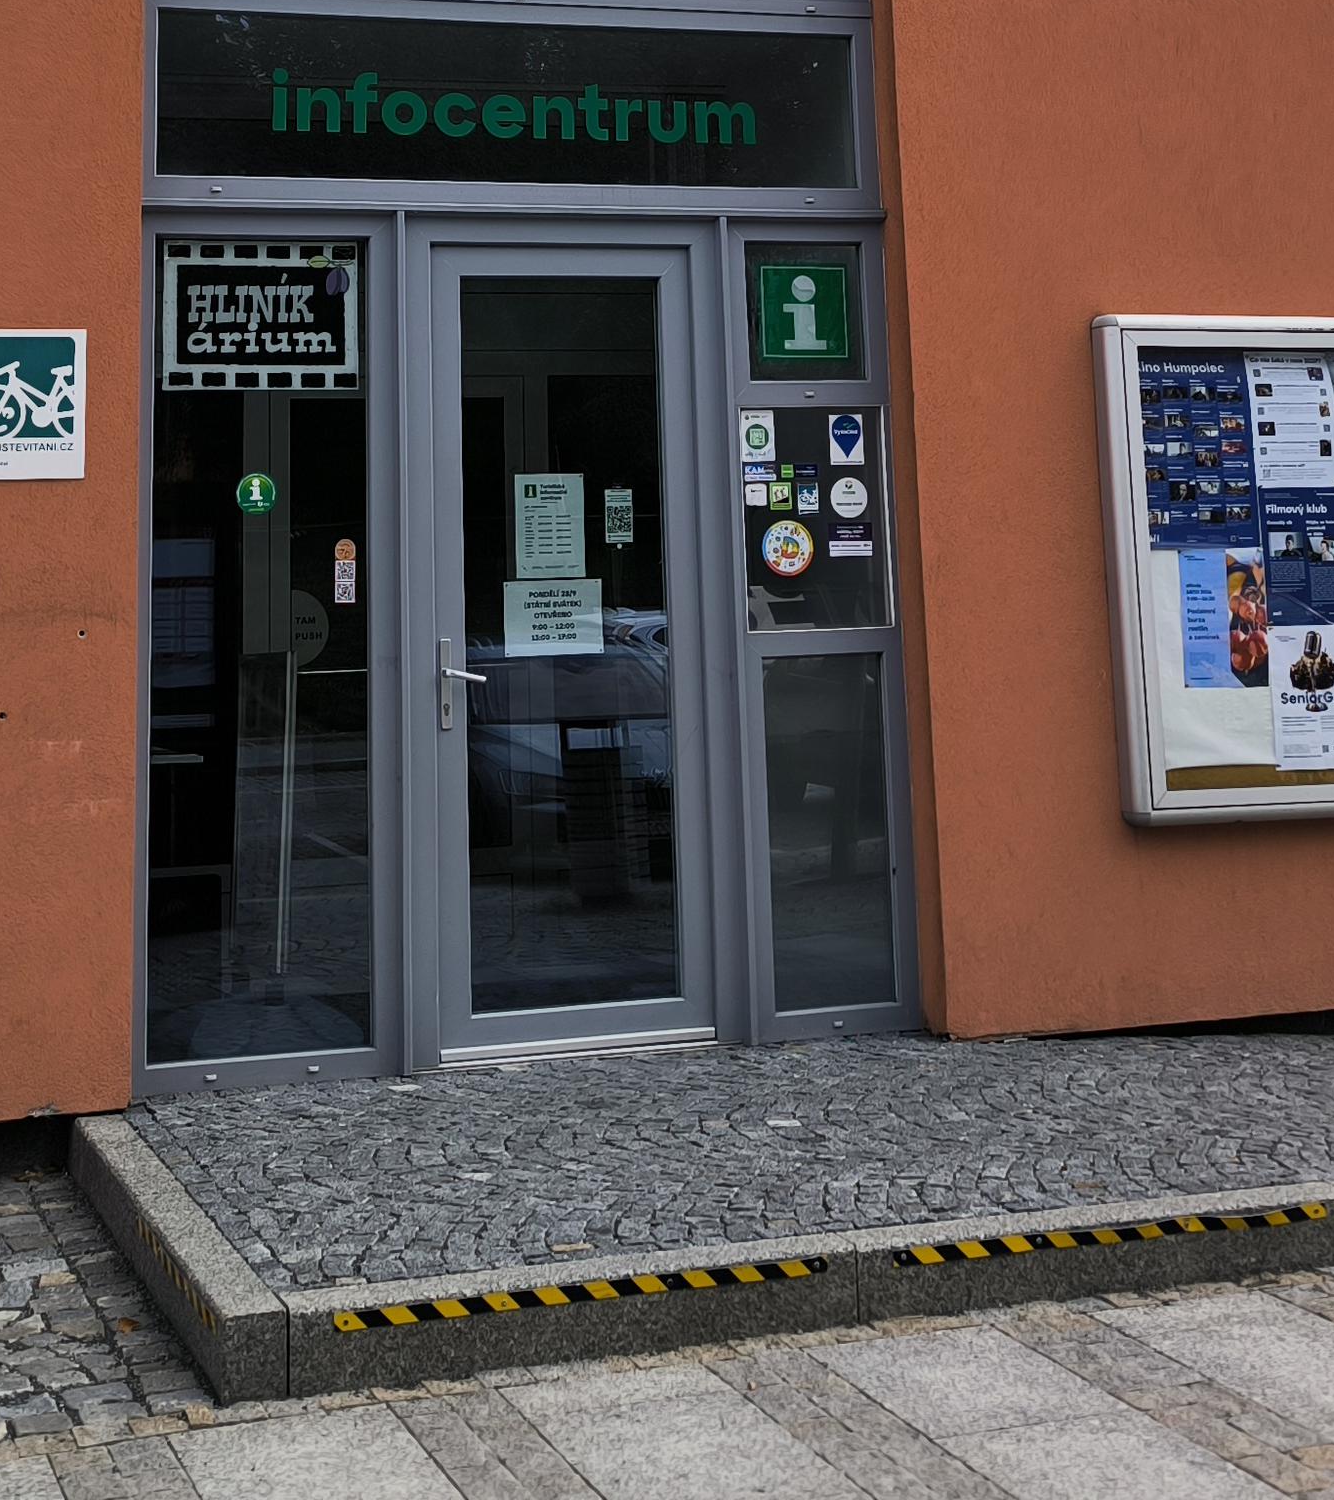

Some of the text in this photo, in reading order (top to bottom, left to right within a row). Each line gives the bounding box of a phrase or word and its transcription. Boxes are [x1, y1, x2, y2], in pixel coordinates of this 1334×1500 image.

[271, 69, 757, 145] infocentrum
[187, 274, 315, 326] HLINÍK
[186, 322, 337, 355] árium
[1163, 363, 1225, 375] Humpolec
[1266, 503, 1327, 516] Filmový klub
[295, 631, 323, 640] PUSH
